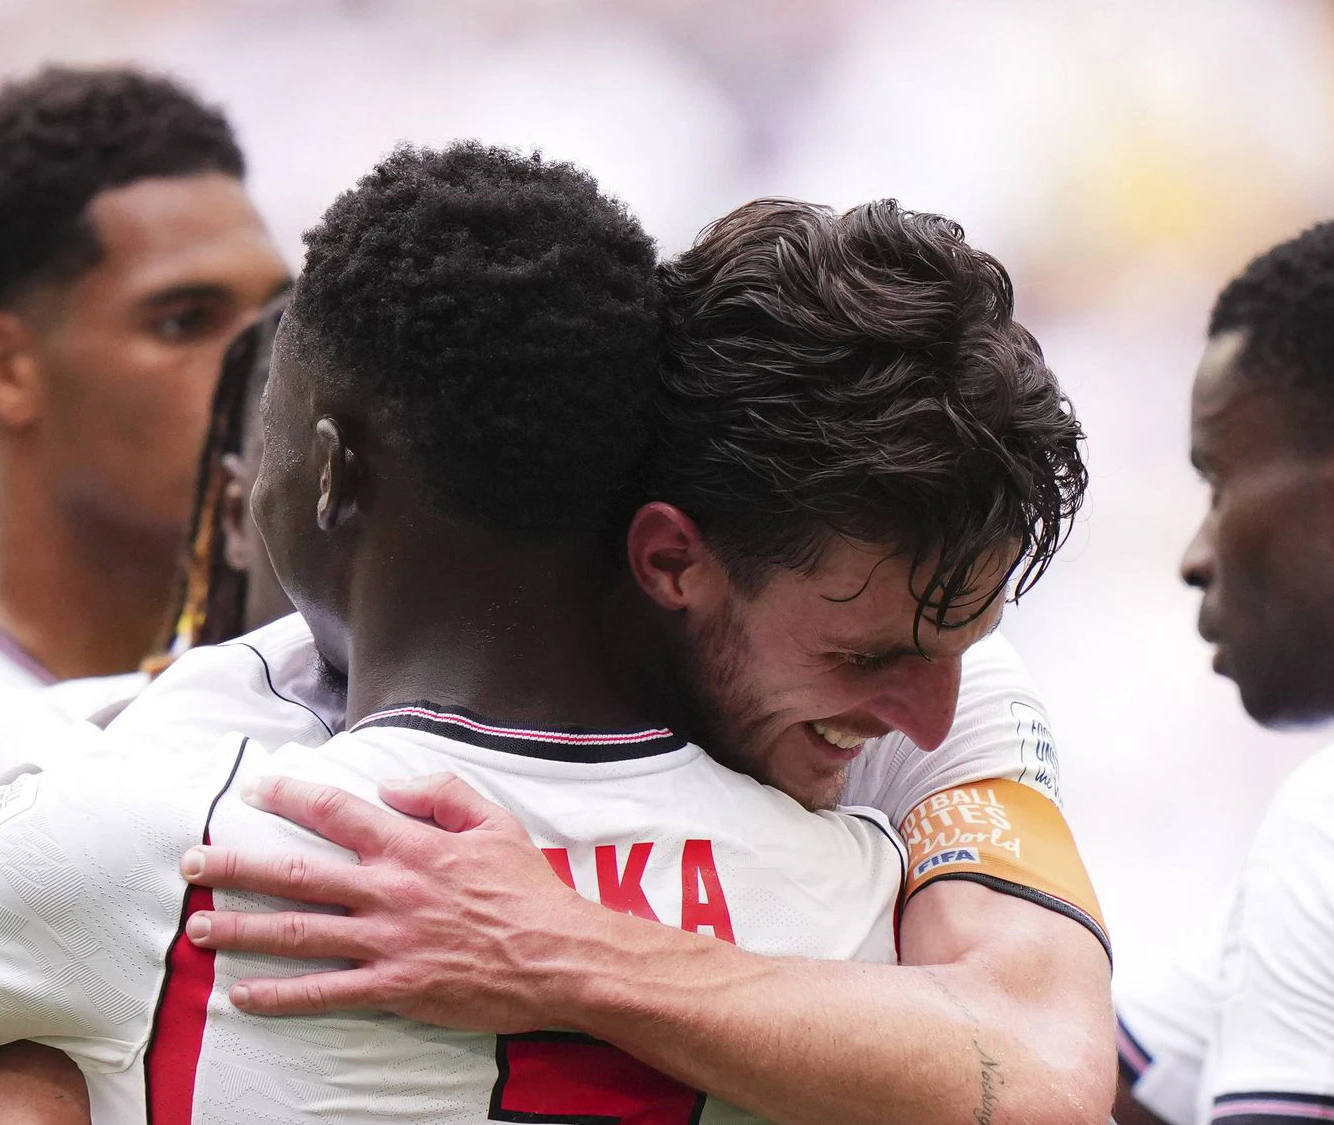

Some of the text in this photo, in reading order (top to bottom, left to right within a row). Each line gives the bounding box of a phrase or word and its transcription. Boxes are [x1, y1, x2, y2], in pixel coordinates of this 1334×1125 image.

[922, 828, 1021, 859] World
[918, 849, 977, 875] FIFA
[541, 839, 737, 946] KA
